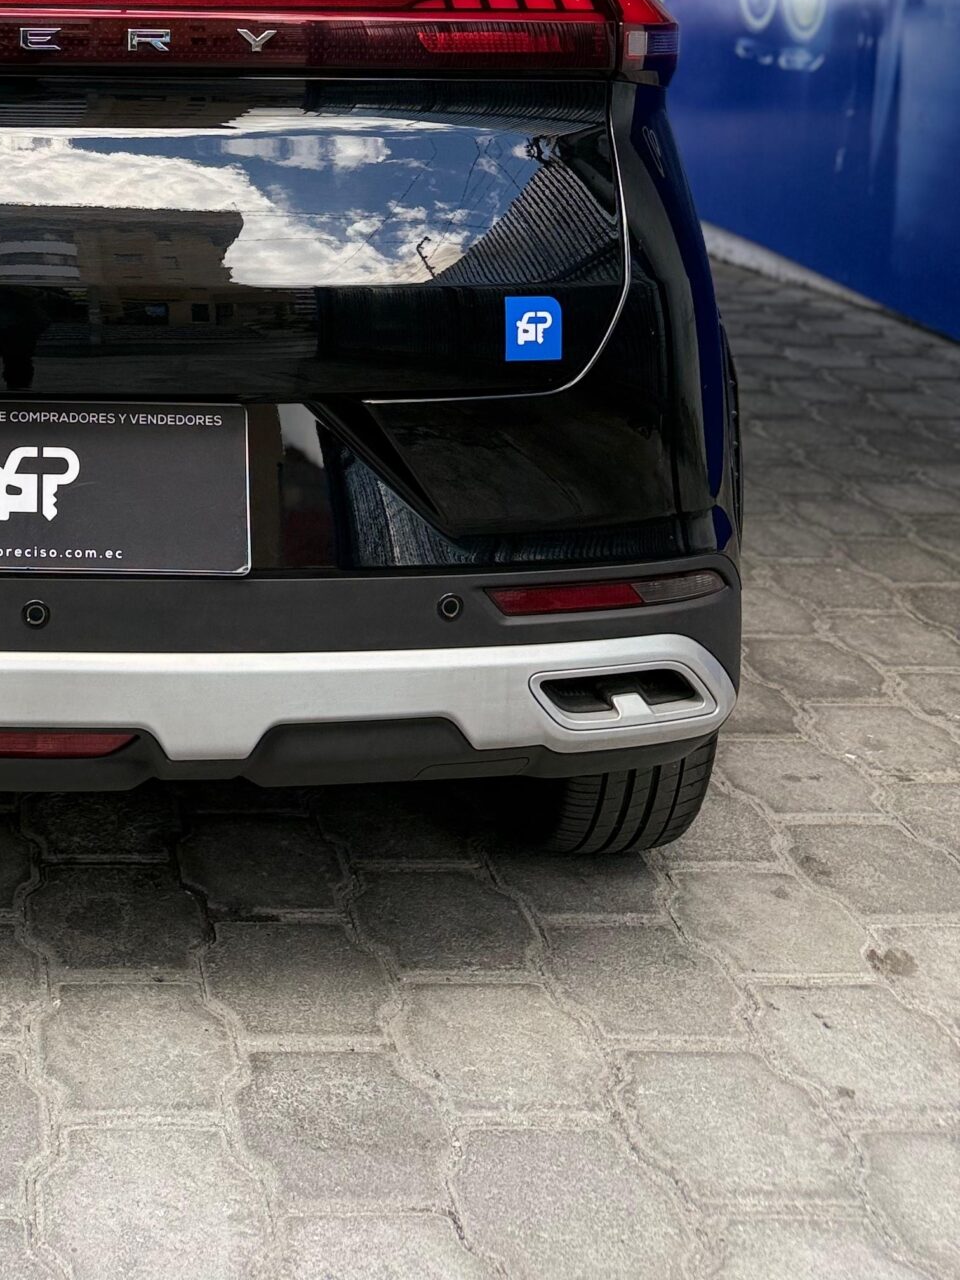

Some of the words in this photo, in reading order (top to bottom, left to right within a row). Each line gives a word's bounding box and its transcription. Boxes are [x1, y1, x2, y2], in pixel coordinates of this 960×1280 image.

[9, 411, 115, 425] COMPRADORES
[118, 413, 127, 425] Y
[130, 413, 222, 426] VENDEDORES
